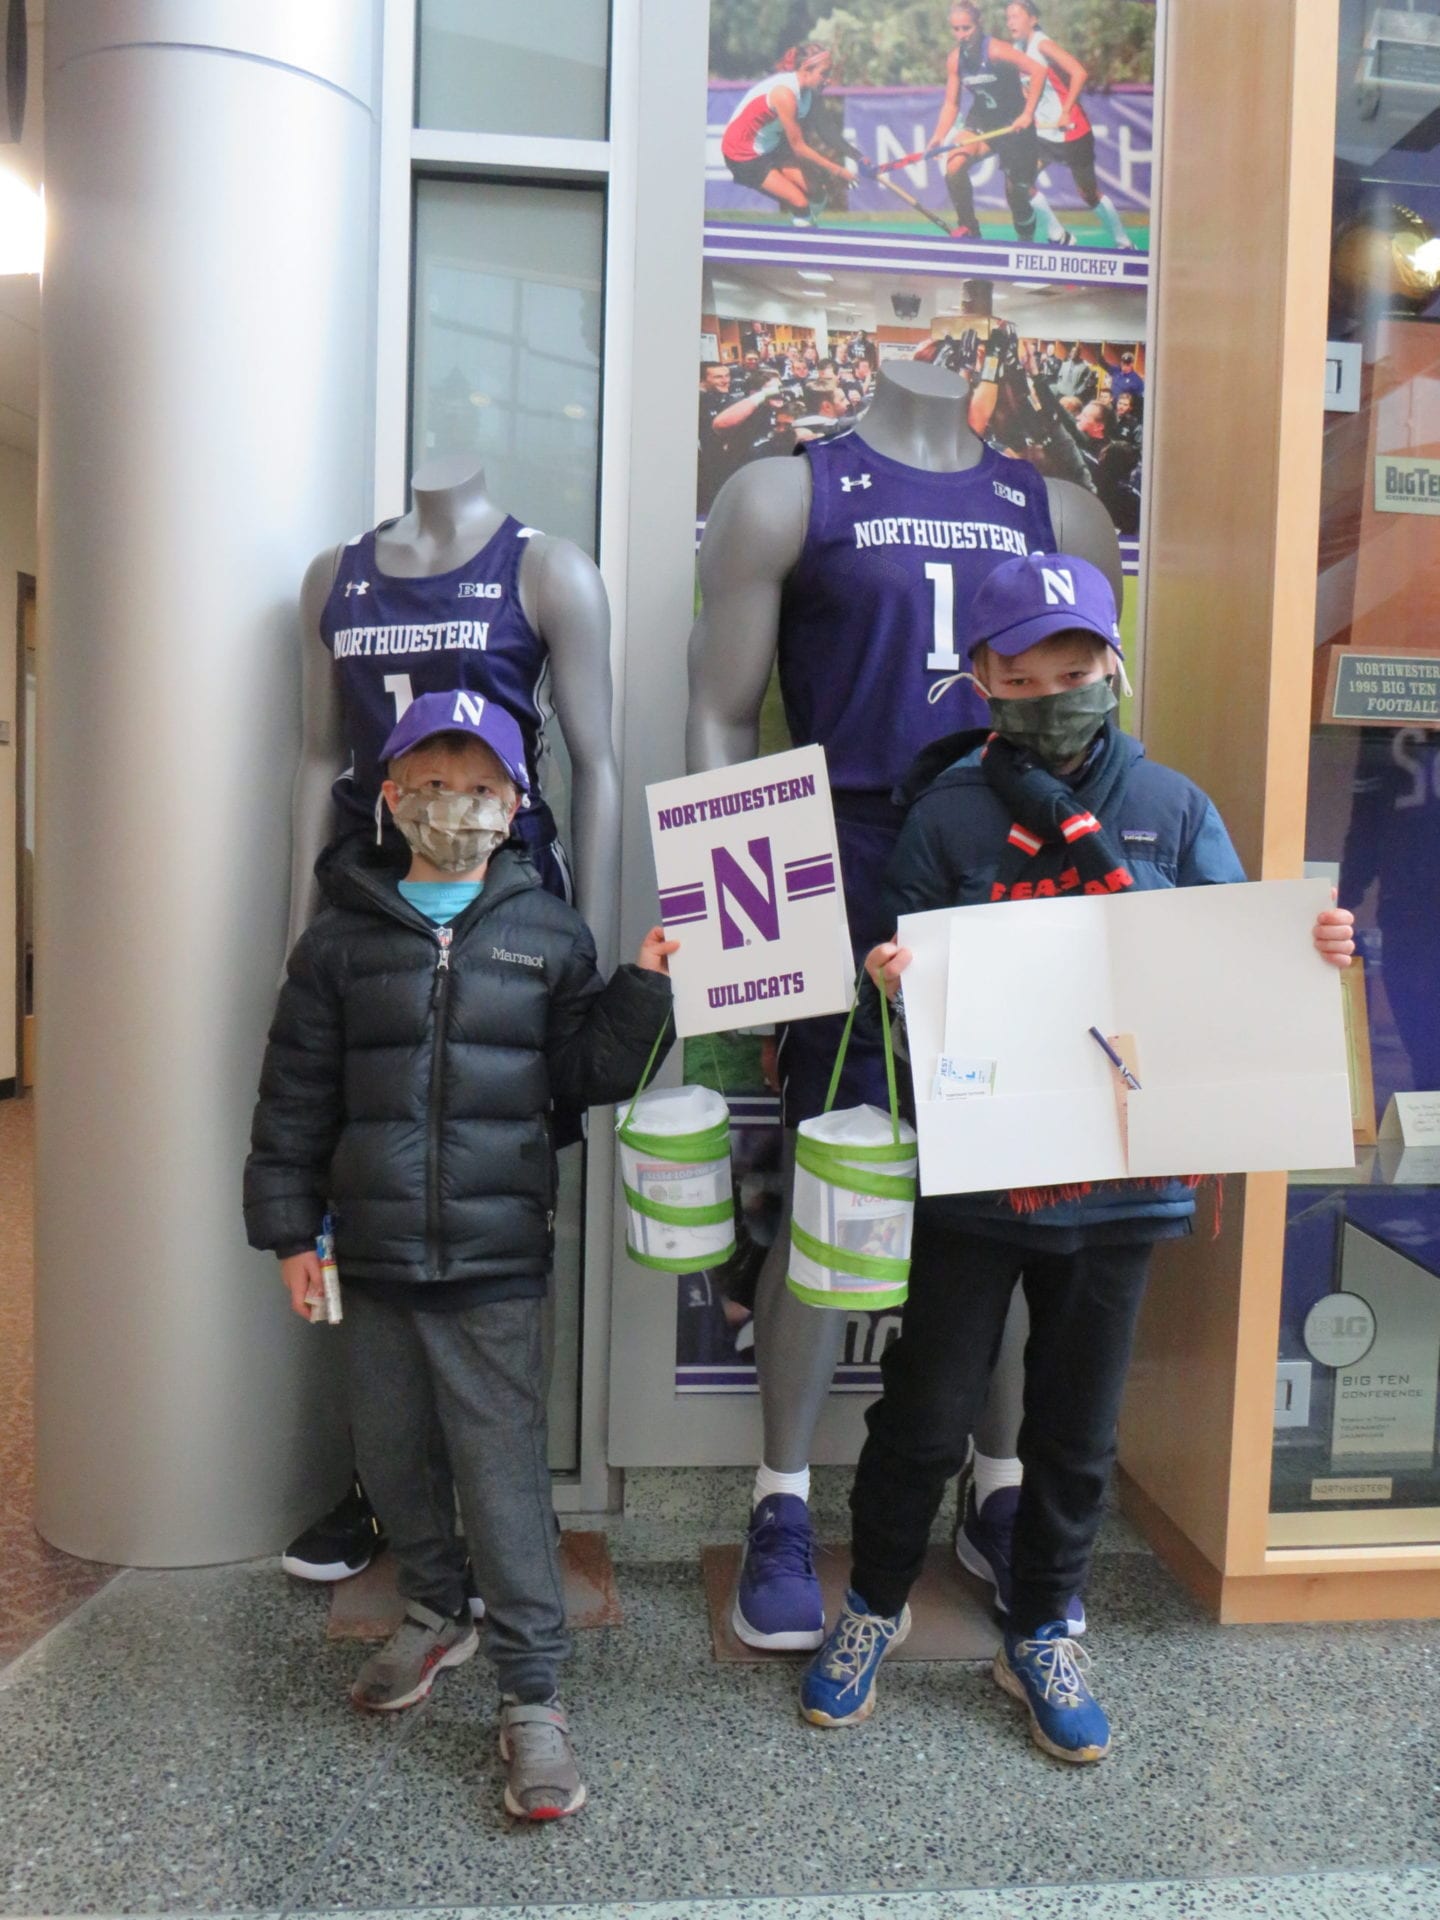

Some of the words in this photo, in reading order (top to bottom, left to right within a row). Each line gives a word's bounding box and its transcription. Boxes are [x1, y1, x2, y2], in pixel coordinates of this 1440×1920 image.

[1015, 254, 1057, 272] FIELD
[1060, 256, 1118, 276] HOCKEY
[853, 518, 1028, 556] NORTHWESTERN
[1041, 568, 1076, 605] N
[924, 562, 960, 671] 1
[333, 620, 490, 660] NORTHWESTERN
[1349, 681, 1378, 693] 1995
[1382, 681, 1406, 694] BIG
[1409, 682, 1437, 696] TEN
[1367, 698, 1438, 713] FOOTBALL
[452, 691, 485, 726] N
[657, 774, 816, 831] NORTHWESTERN
[710, 836, 780, 951] N
[491, 947, 544, 968] Marmot
[707, 971, 805, 1008] WILDCATS
[1341, 1389, 1424, 1399] CONFERENCE
[1342, 1375, 1371, 1386] BIG
[1377, 1374, 1411, 1385] TEN
